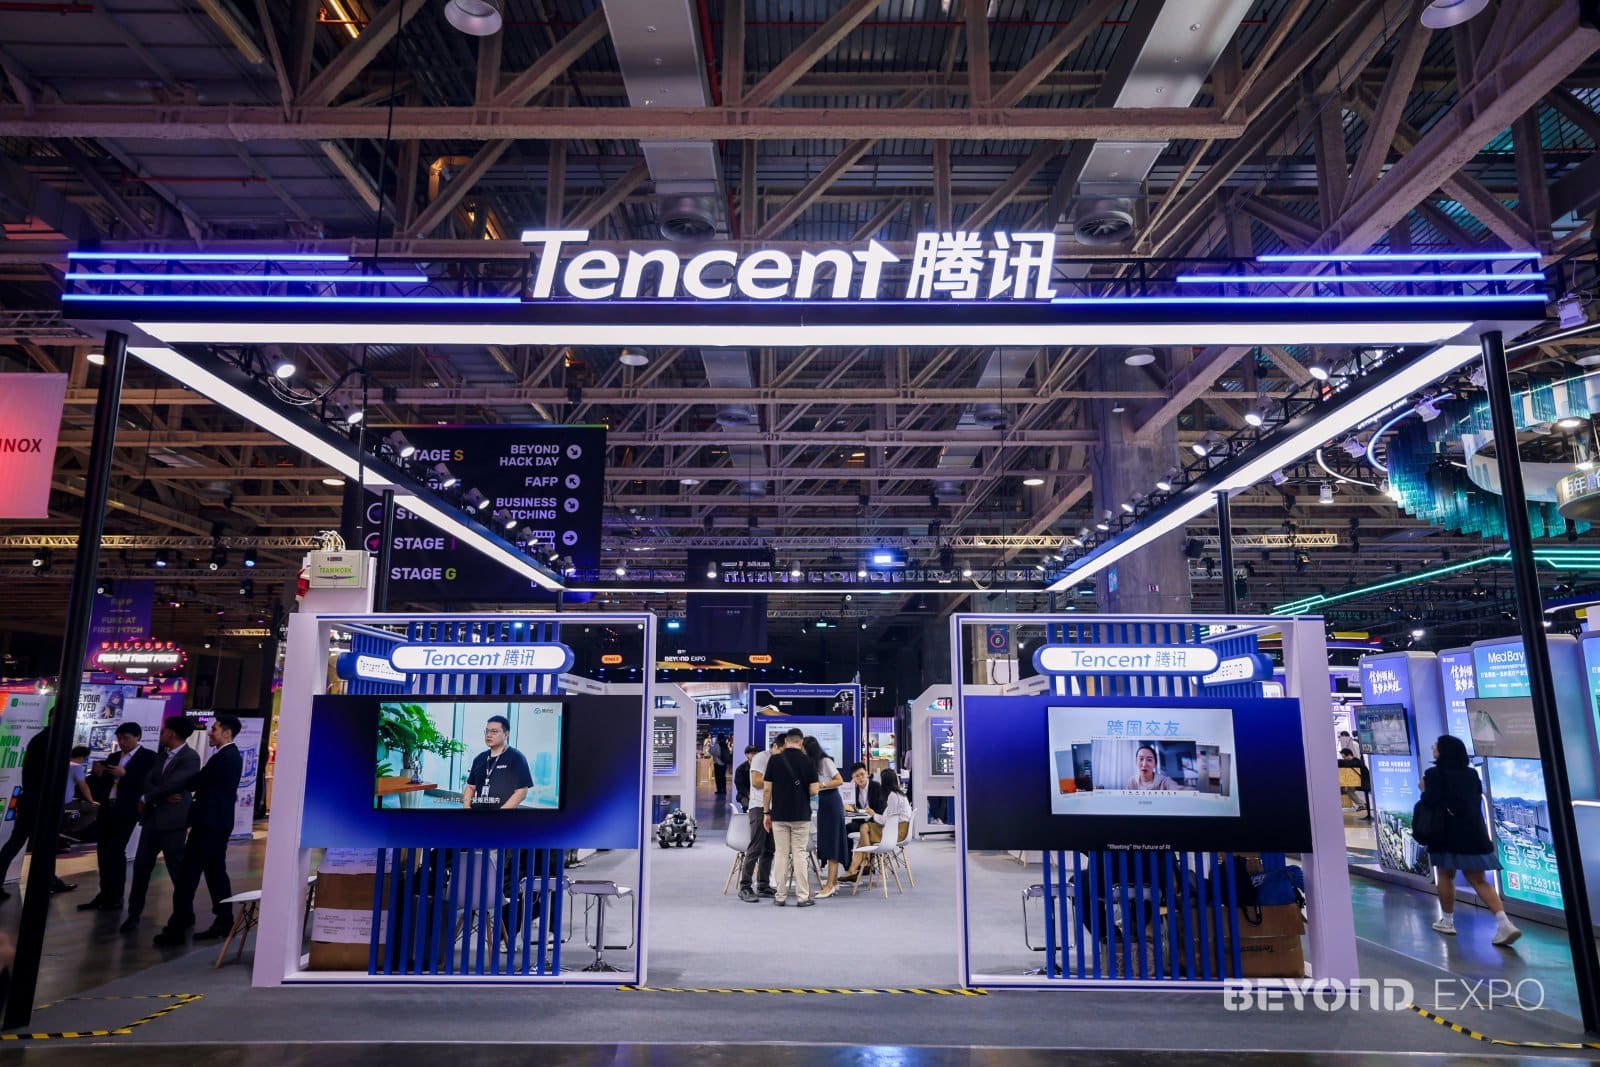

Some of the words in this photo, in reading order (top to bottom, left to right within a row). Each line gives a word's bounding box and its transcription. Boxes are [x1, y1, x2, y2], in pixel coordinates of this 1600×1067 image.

[520, 229, 901, 299] Tencent
[905, 231, 1058, 299] 腾讯
[412, 449, 451, 461] TAGE
[454, 449, 465, 461] S
[511, 444, 560, 454] BEYOND
[499, 456, 533, 466] HACK
[535, 456, 560, 466] DAY
[525, 476, 559, 487] FAFP
[496, 497, 557, 508] BUSINESS
[493, 509, 556, 520] TCHING
[393, 537, 445, 550] STAGE
[391, 567, 442, 580] STAGE
[445, 567, 457, 580] G
[102, 642, 174, 650] WELCOME
[423, 648, 501, 666] Tencent
[503, 649, 535, 666] 腾讯
[1071, 650, 1152, 668] Tencent
[1155, 651, 1187, 667] 腾讯
[1106, 719, 1181, 737] 跨国交友
